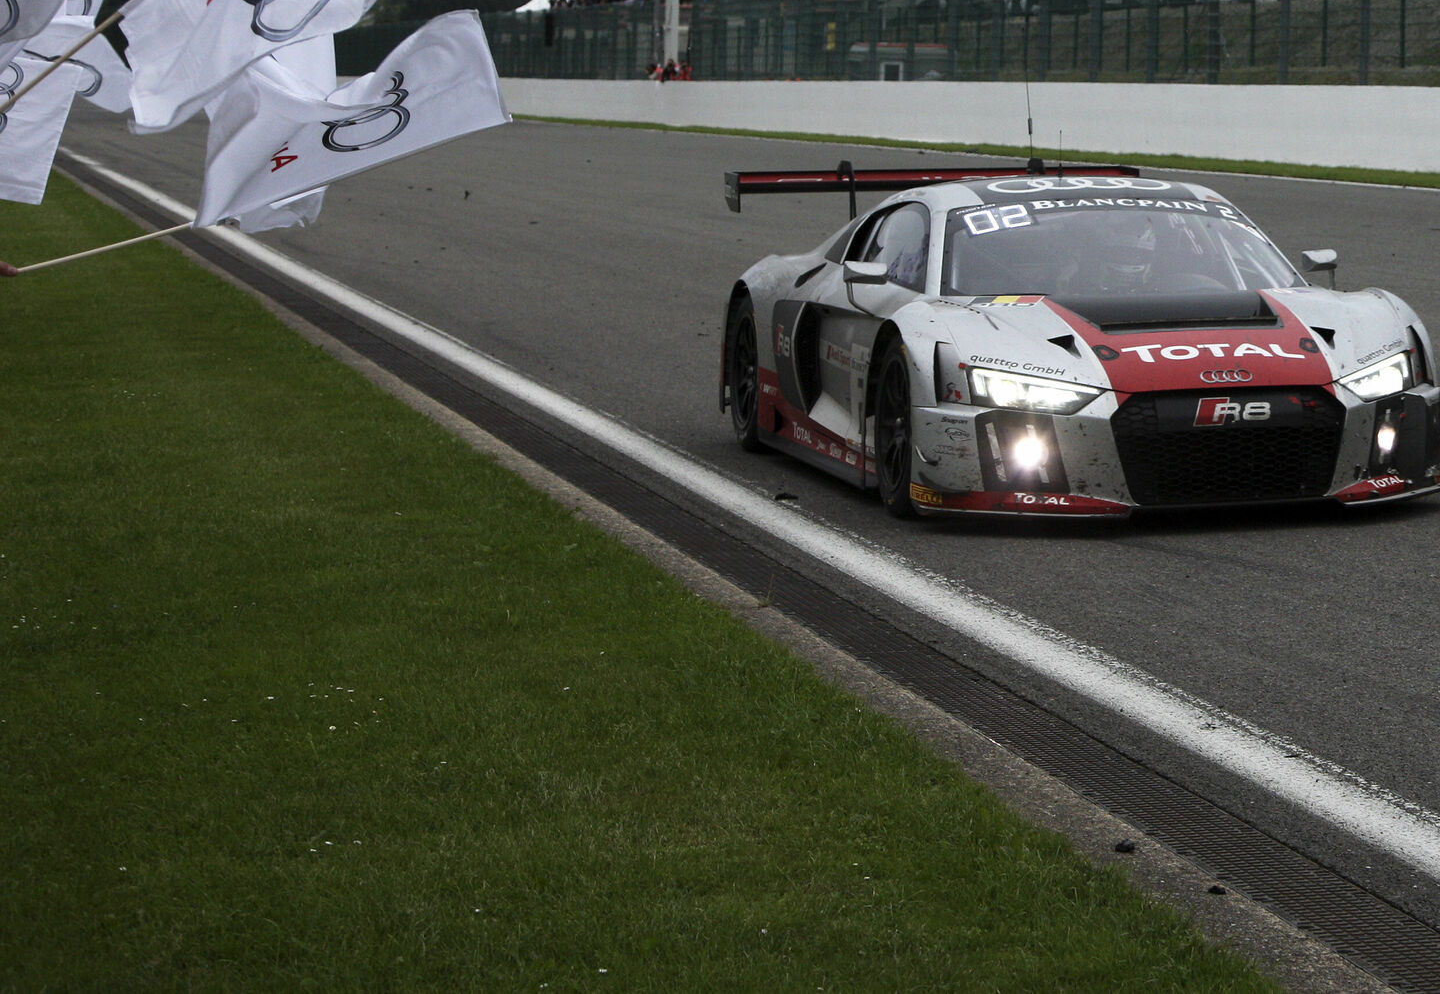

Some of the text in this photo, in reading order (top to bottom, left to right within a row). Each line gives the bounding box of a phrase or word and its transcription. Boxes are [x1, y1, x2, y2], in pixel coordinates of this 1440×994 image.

[1031, 198, 1208, 213] BLANCPAIN
[1215, 204, 1238, 220] 2
[963, 204, 1032, 236] 02
[1121, 342, 1306, 363] TOTAL
[970, 354, 1067, 376] quattro GmbH
[1210, 400, 1272, 424] R8
[1368, 475, 1405, 489] TOTAL
